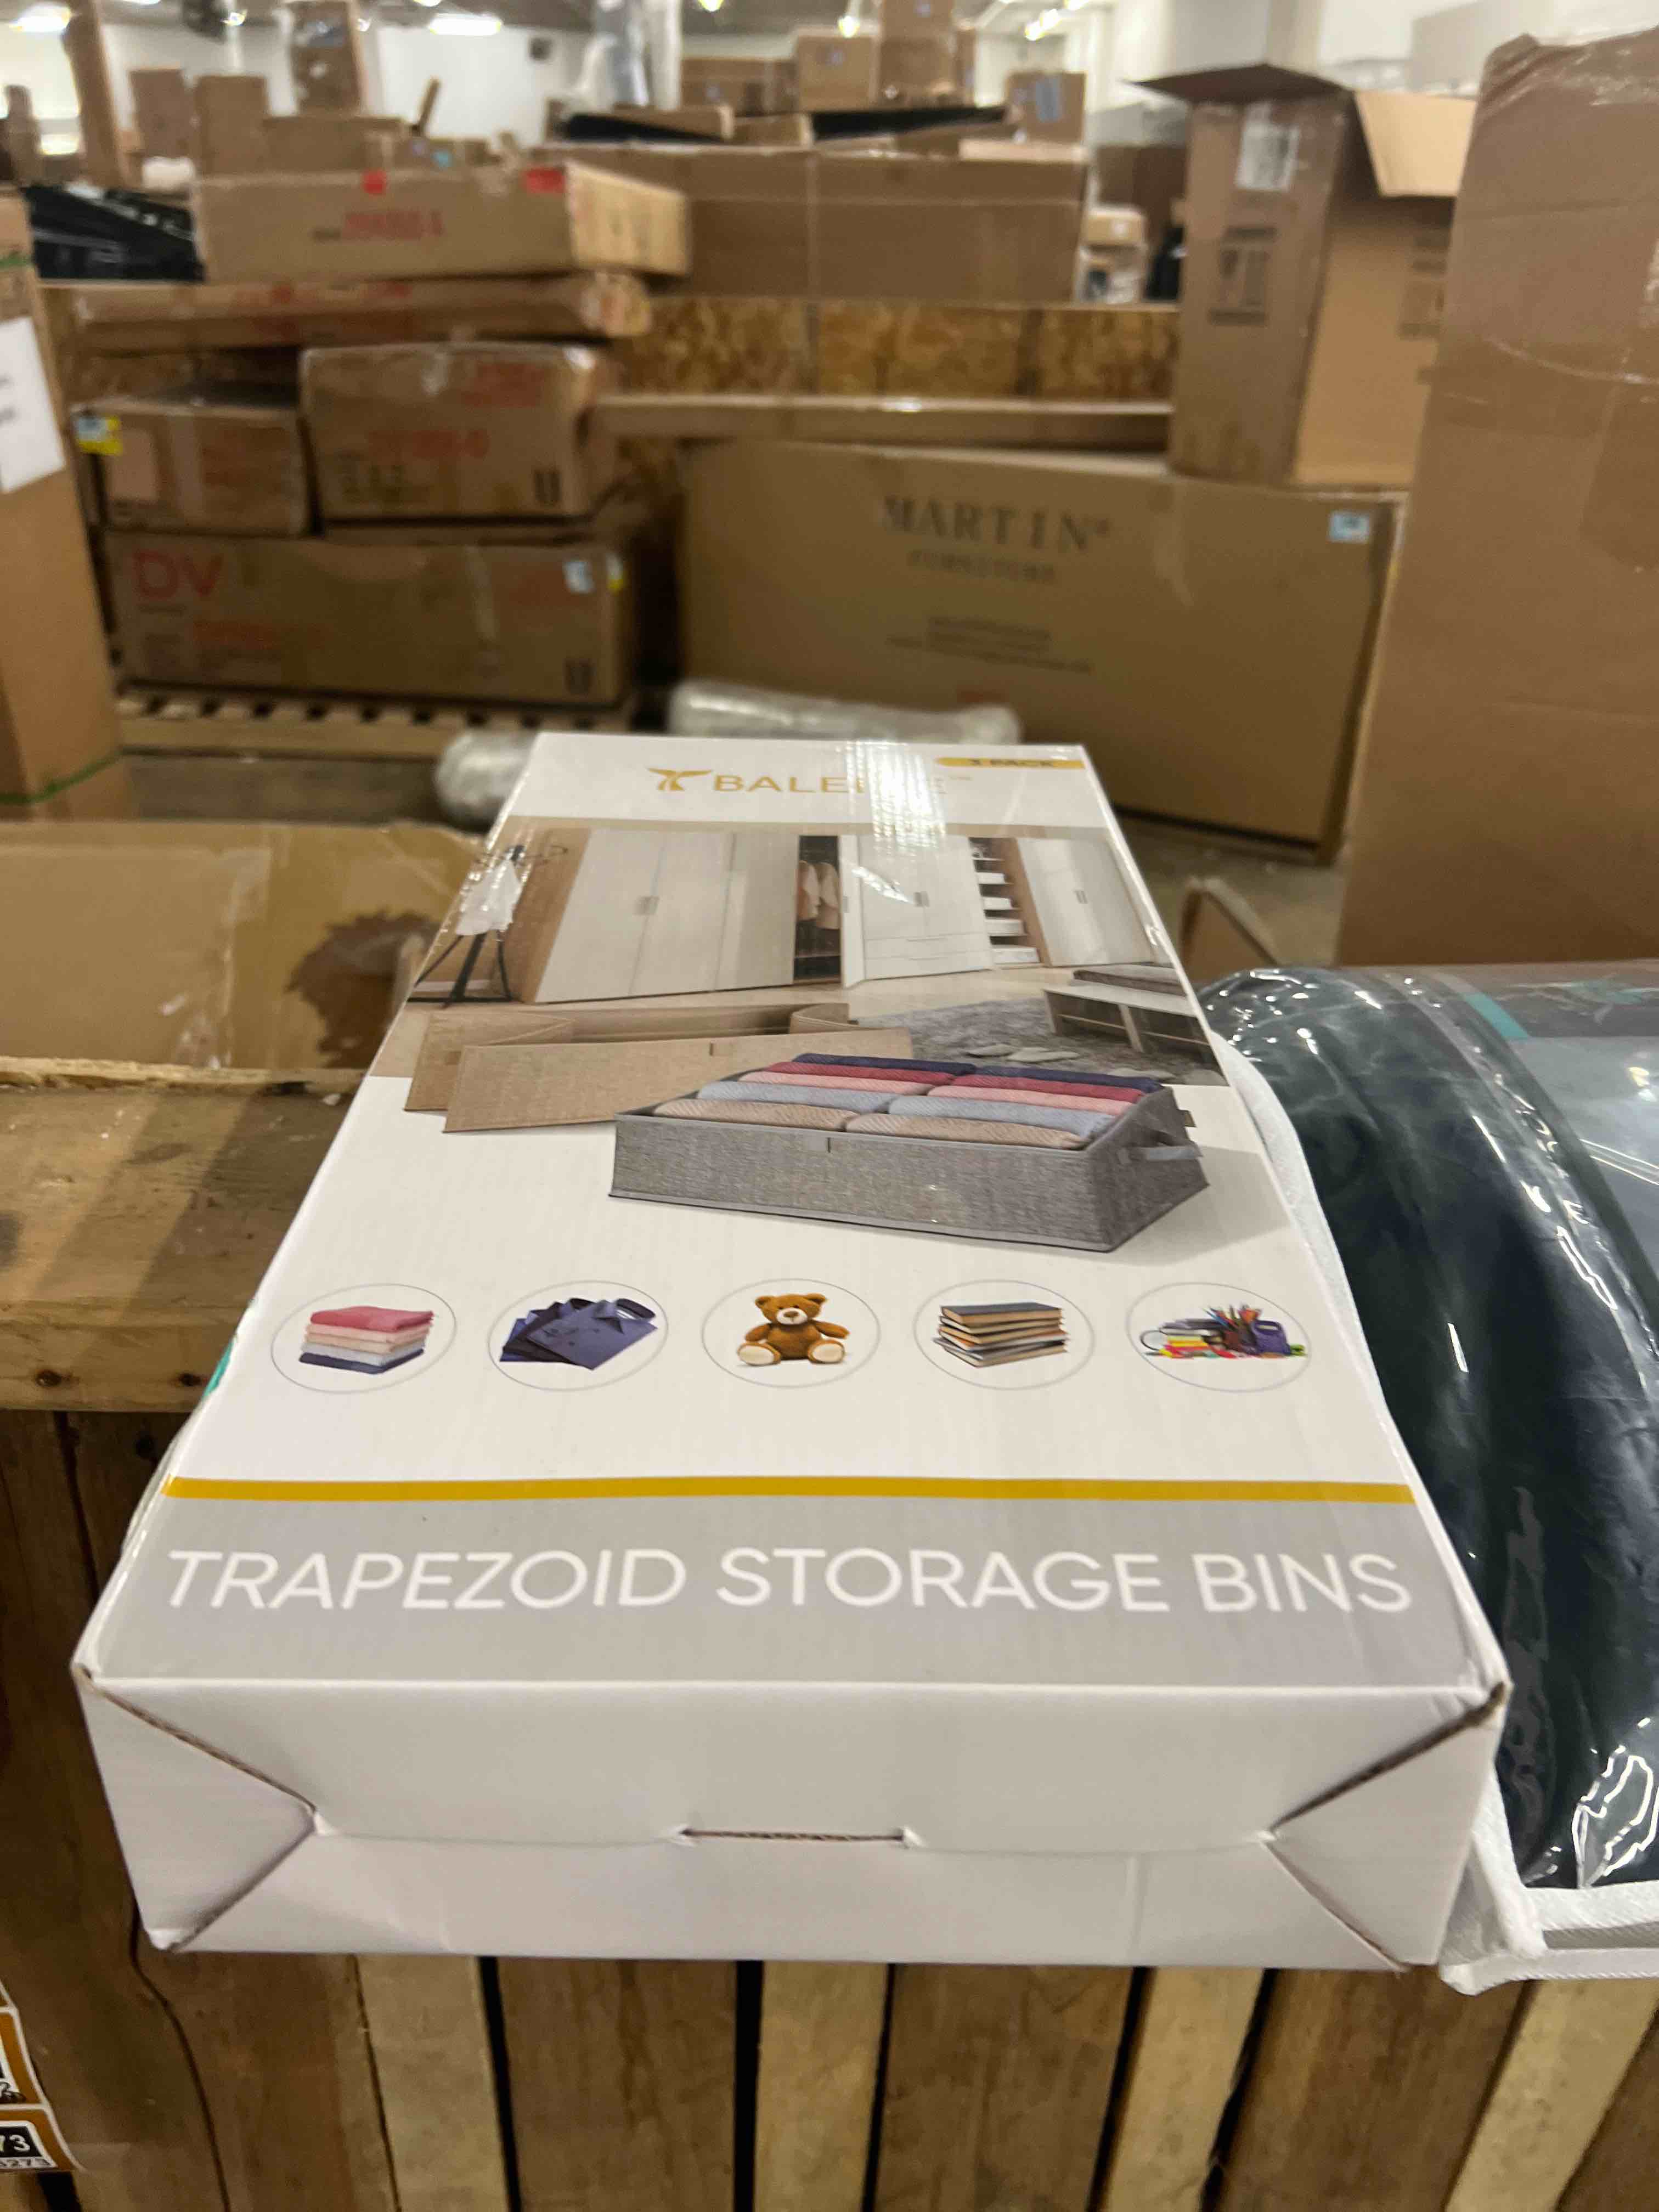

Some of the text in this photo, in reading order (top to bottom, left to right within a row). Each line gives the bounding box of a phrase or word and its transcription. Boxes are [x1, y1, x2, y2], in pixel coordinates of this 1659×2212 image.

[884, 494, 1091, 553] MARTIN
[713, 774, 948, 794] BALEI
[168, 1547, 1413, 1614] TRAPEZOID STORAGE BINS
